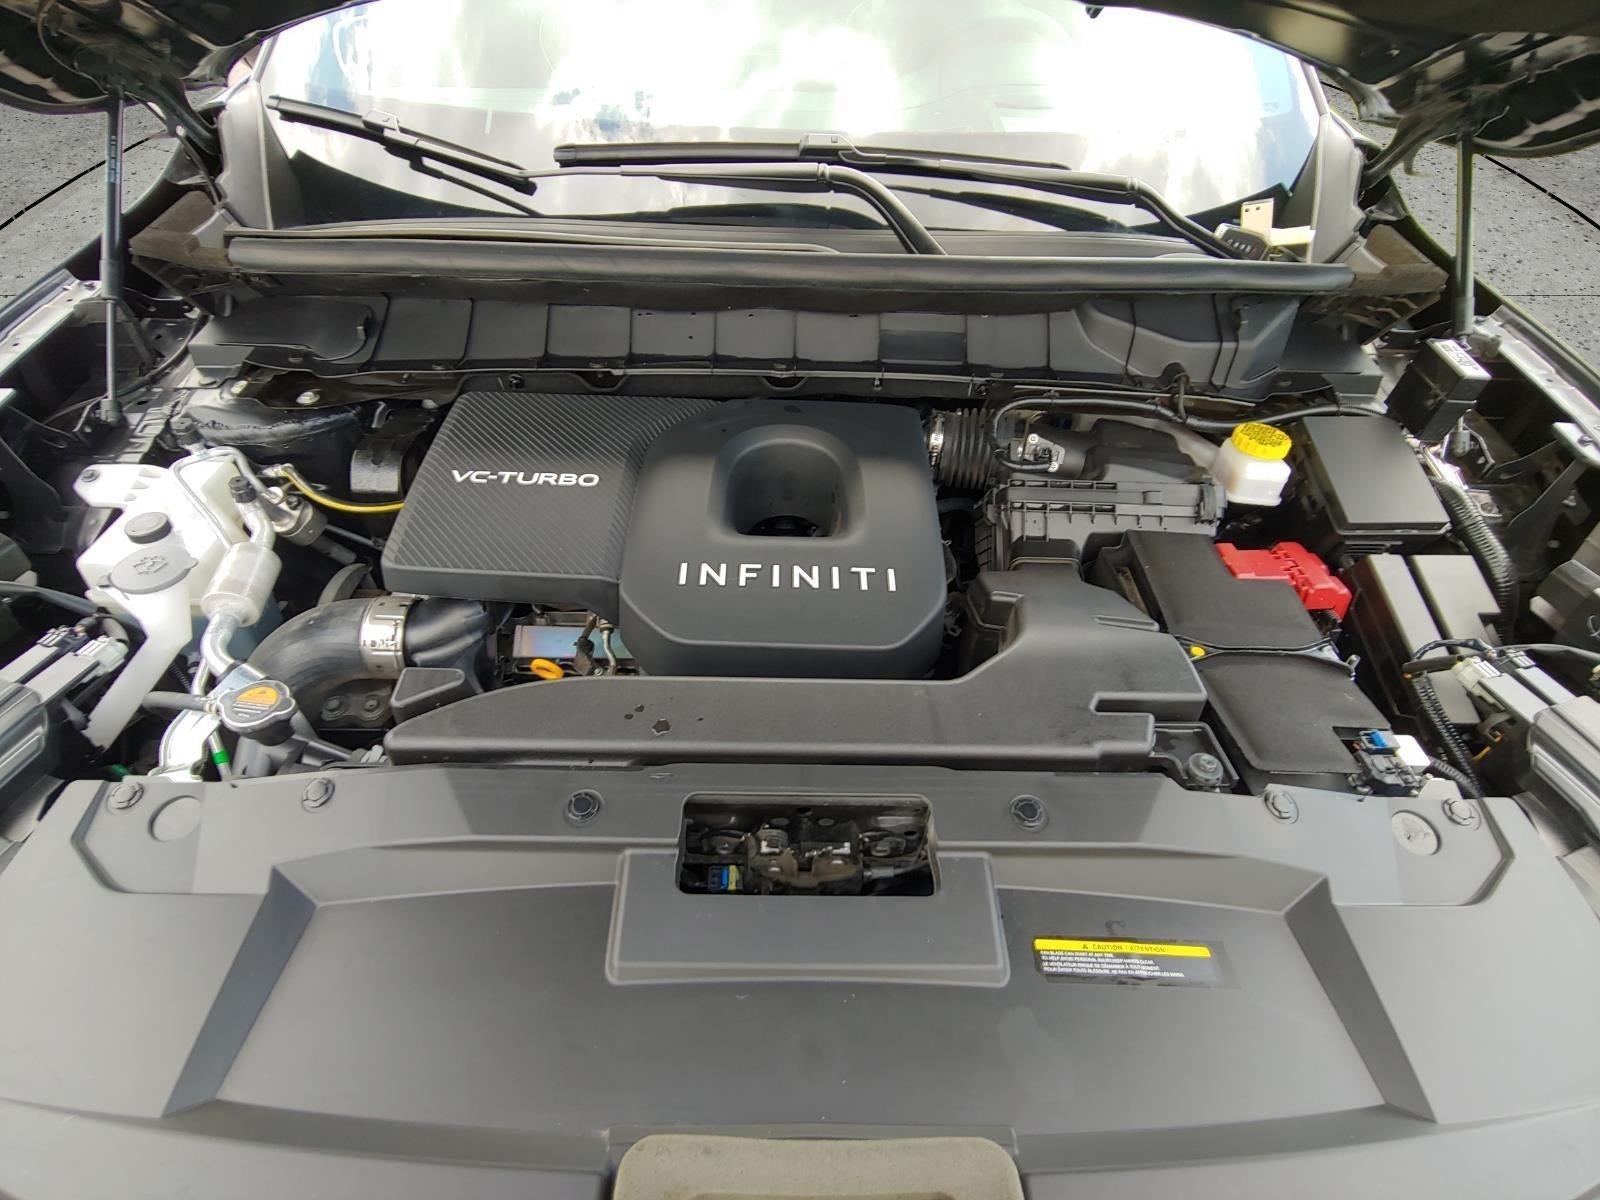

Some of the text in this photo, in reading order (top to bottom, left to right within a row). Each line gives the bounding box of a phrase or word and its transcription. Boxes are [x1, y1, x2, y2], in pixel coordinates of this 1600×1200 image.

[451, 469, 600, 487] VC-TURBO
[678, 562, 897, 592] INFINITI
[1092, 943, 1122, 951] CAUTION
[1130, 945, 1166, 953] ATTENTION
